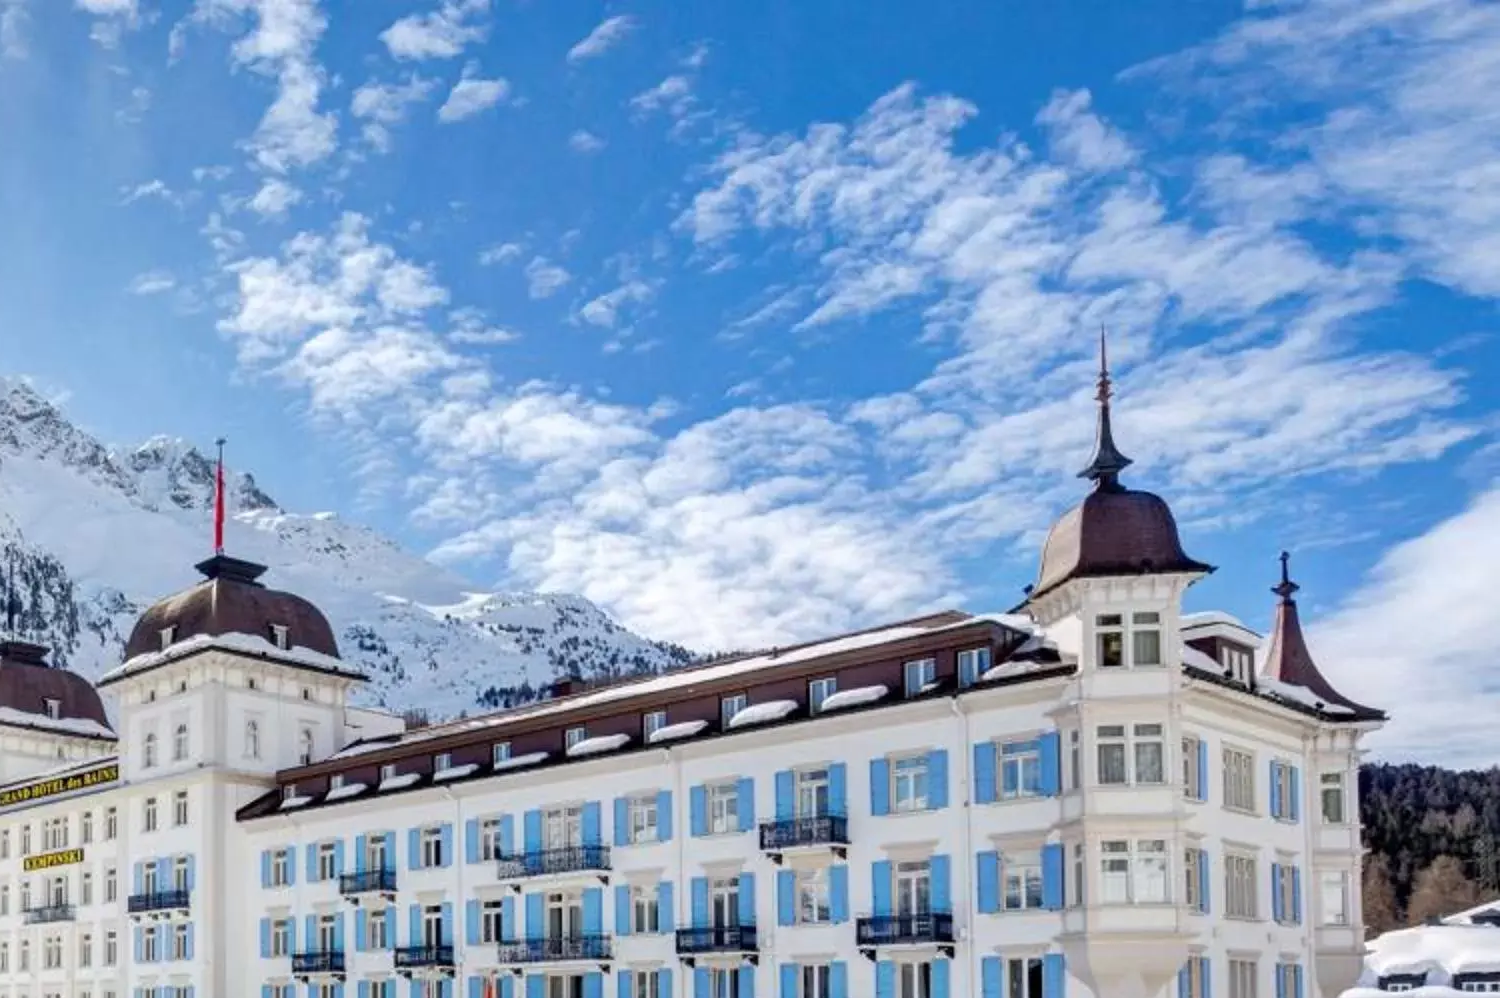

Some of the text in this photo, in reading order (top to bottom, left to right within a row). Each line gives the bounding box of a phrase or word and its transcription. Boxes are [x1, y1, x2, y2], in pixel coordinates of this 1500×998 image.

[32, 780, 64, 798] HOTEL
[67, 777, 82, 789] des
[25, 849, 81, 870] KEMPINSKI
